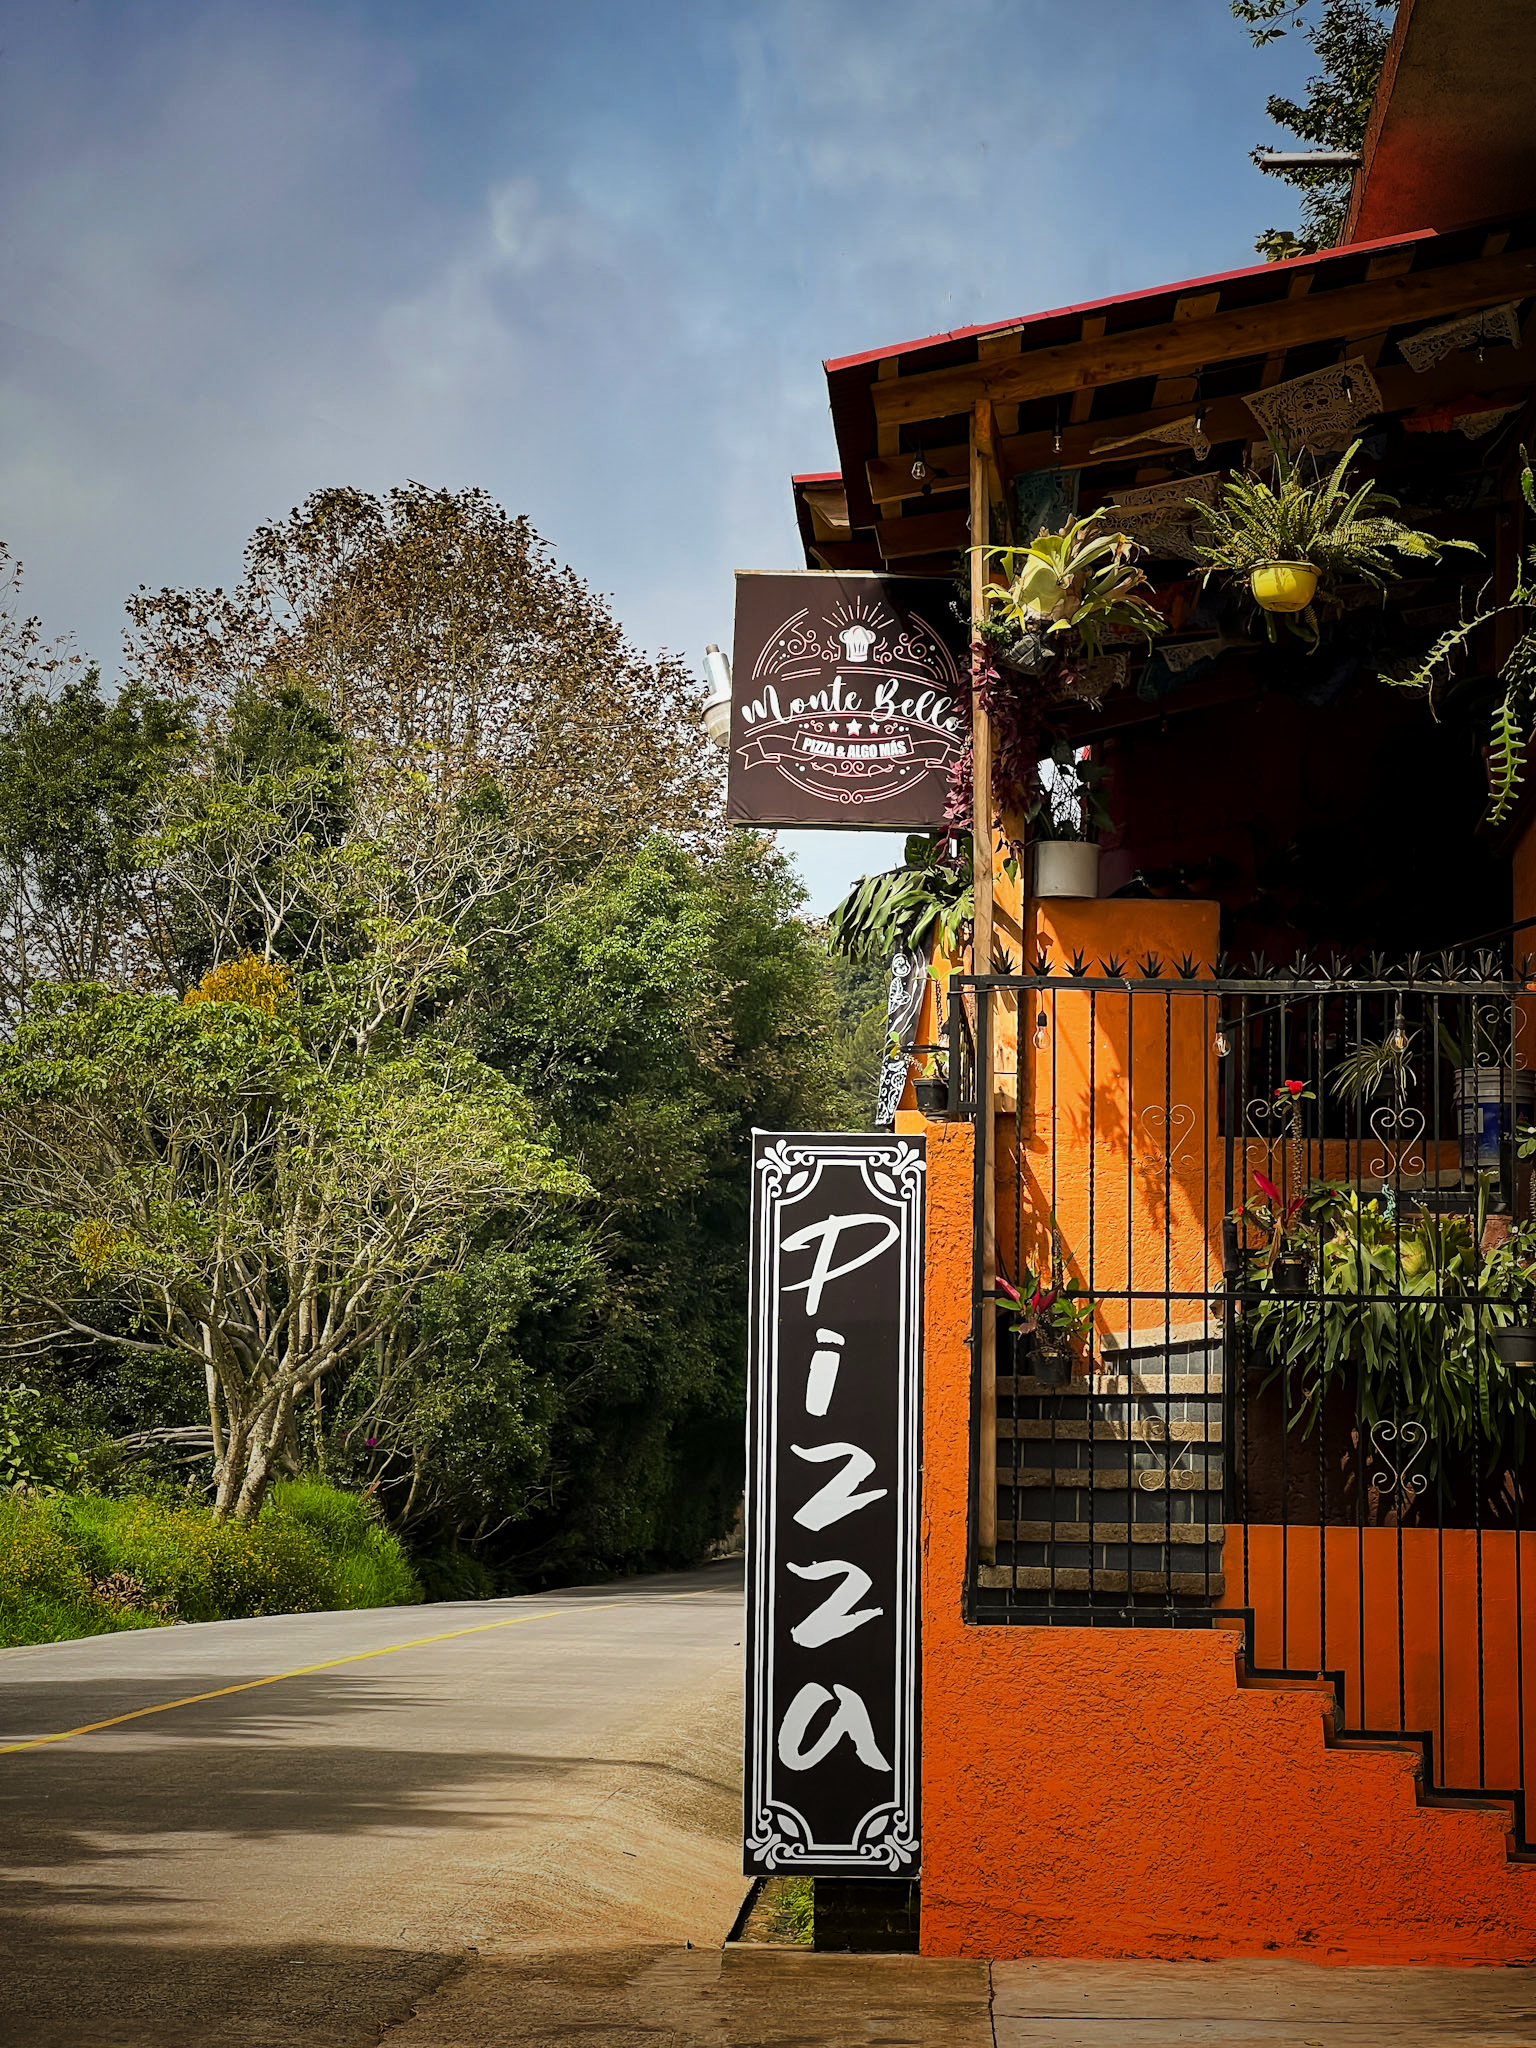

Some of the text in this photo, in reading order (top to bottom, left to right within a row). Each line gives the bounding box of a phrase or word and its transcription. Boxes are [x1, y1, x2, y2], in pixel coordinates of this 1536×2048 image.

[741, 675, 964, 732] Monte Bello
[802, 737, 907, 758] PIZZA & ALGO MÁS
[778, 1213, 901, 1774] Pizza
